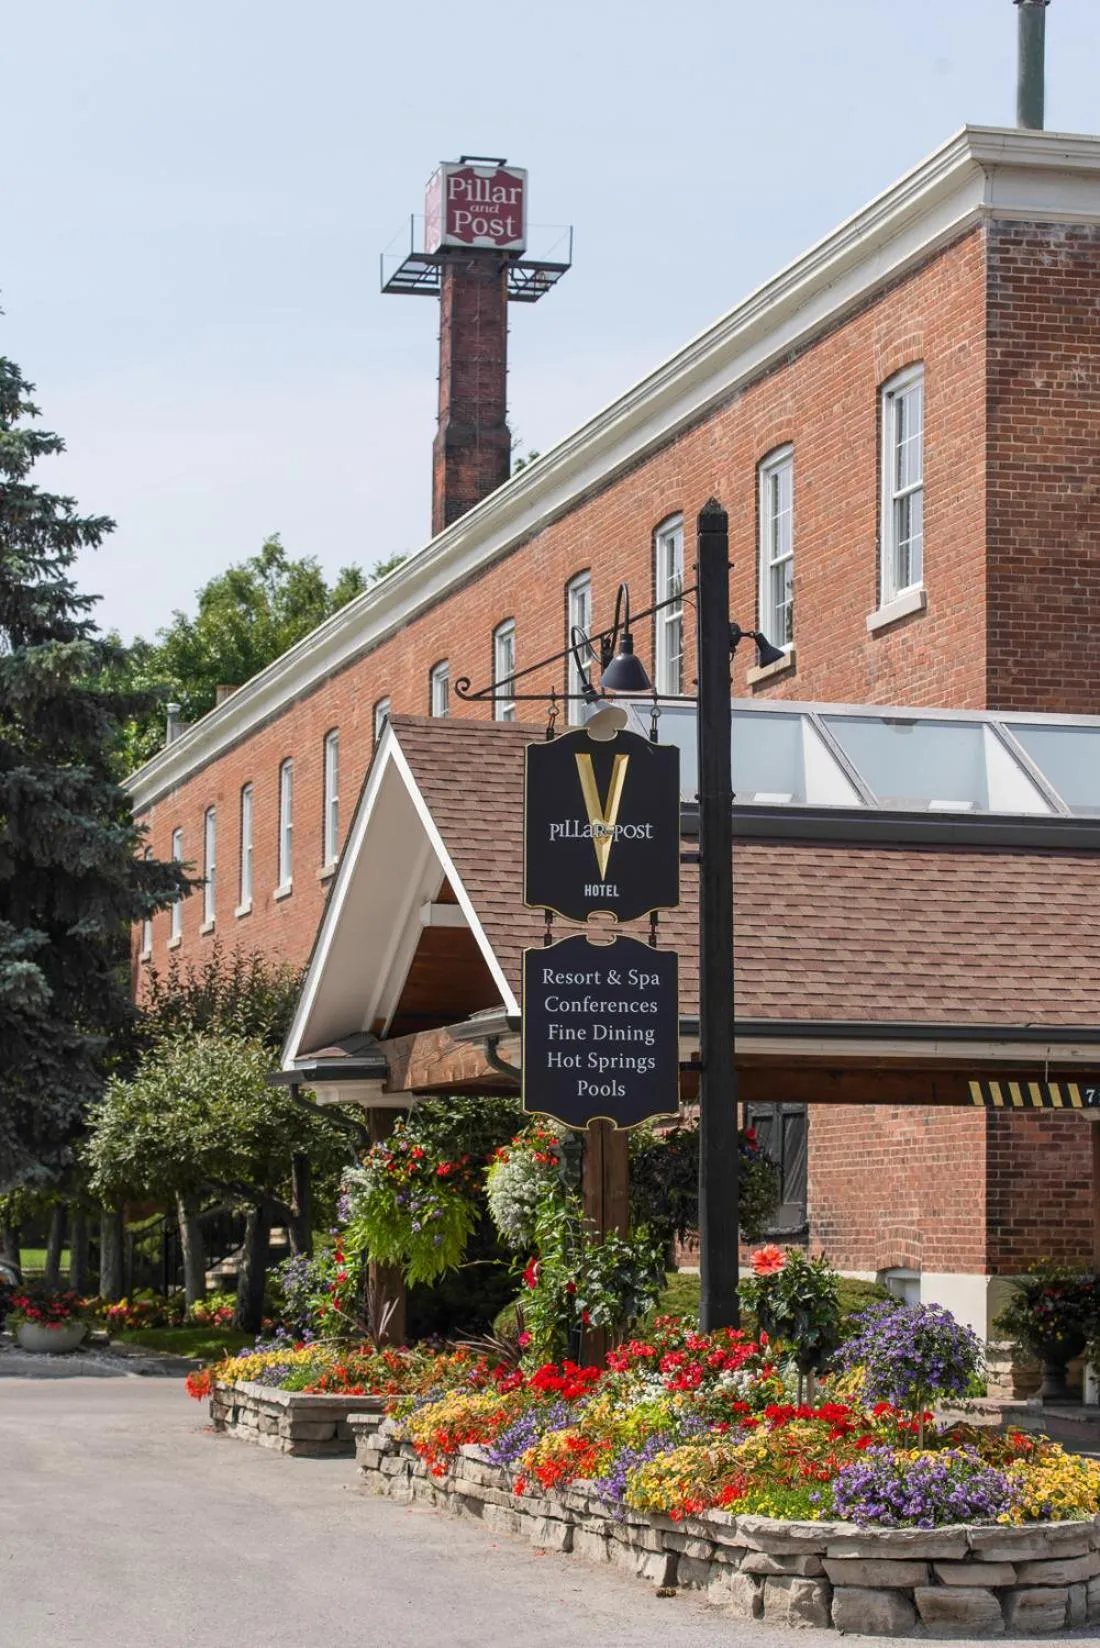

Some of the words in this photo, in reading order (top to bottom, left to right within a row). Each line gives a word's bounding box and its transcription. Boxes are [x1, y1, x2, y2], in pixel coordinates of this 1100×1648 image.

[448, 177, 522, 204] Pillar
[469, 204, 499, 214] and
[453, 210, 517, 237] Post
[584, 884, 619, 897] HOTEL
[543, 969, 600, 984] Resort
[607, 970, 621, 985] &
[628, 969, 660, 989] Spa
[545, 996, 657, 1012] Conferences
[548, 1024, 586, 1040] Fine
[593, 1025, 654, 1045] Dining
[548, 1052, 581, 1067] Hot
[588, 1052, 655, 1073] Springs
[578, 1080, 625, 1096] Pools
